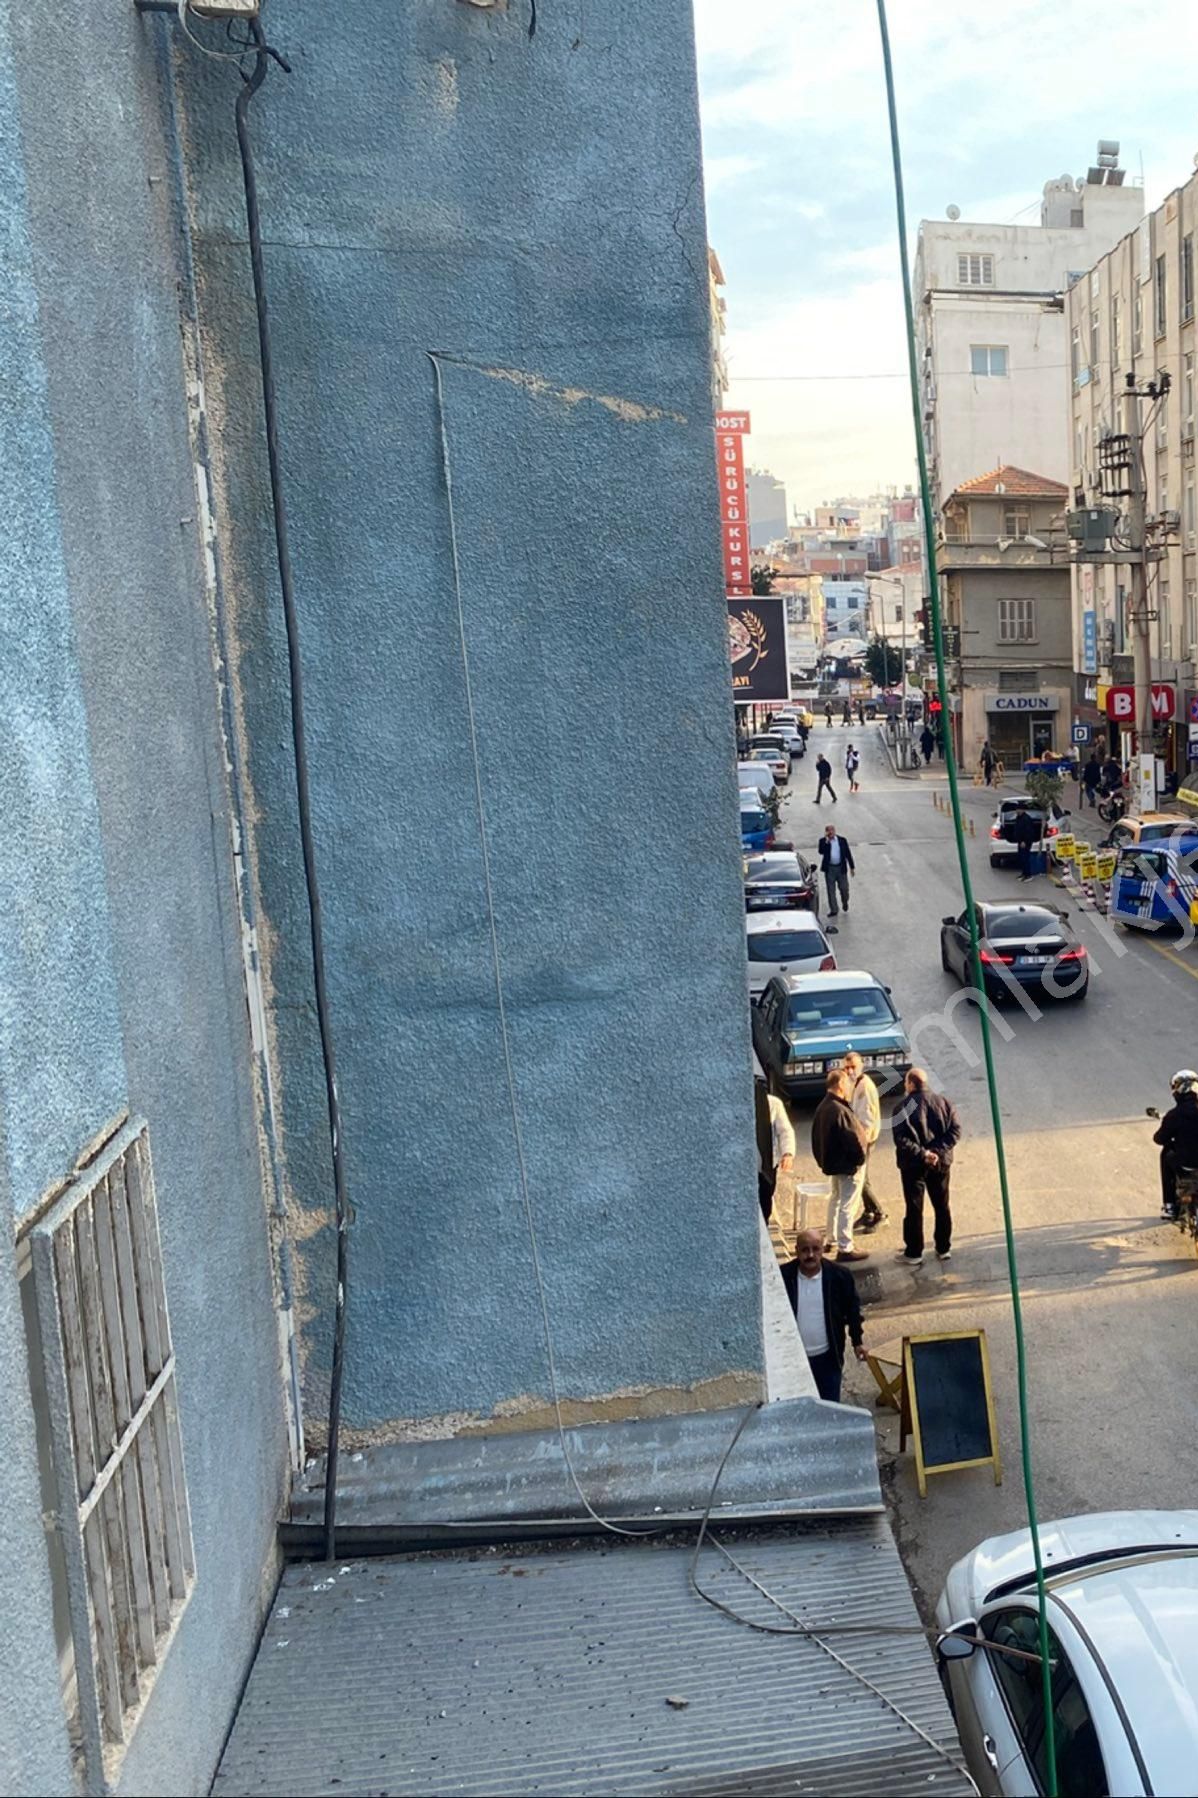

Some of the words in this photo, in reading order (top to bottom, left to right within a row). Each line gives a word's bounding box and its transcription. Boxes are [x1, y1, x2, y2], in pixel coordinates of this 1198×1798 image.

[723, 436, 740, 520] SÜRÜCÜ
[996, 697, 1049, 710] CADUN
[1113, 692, 1170, 716] BM
